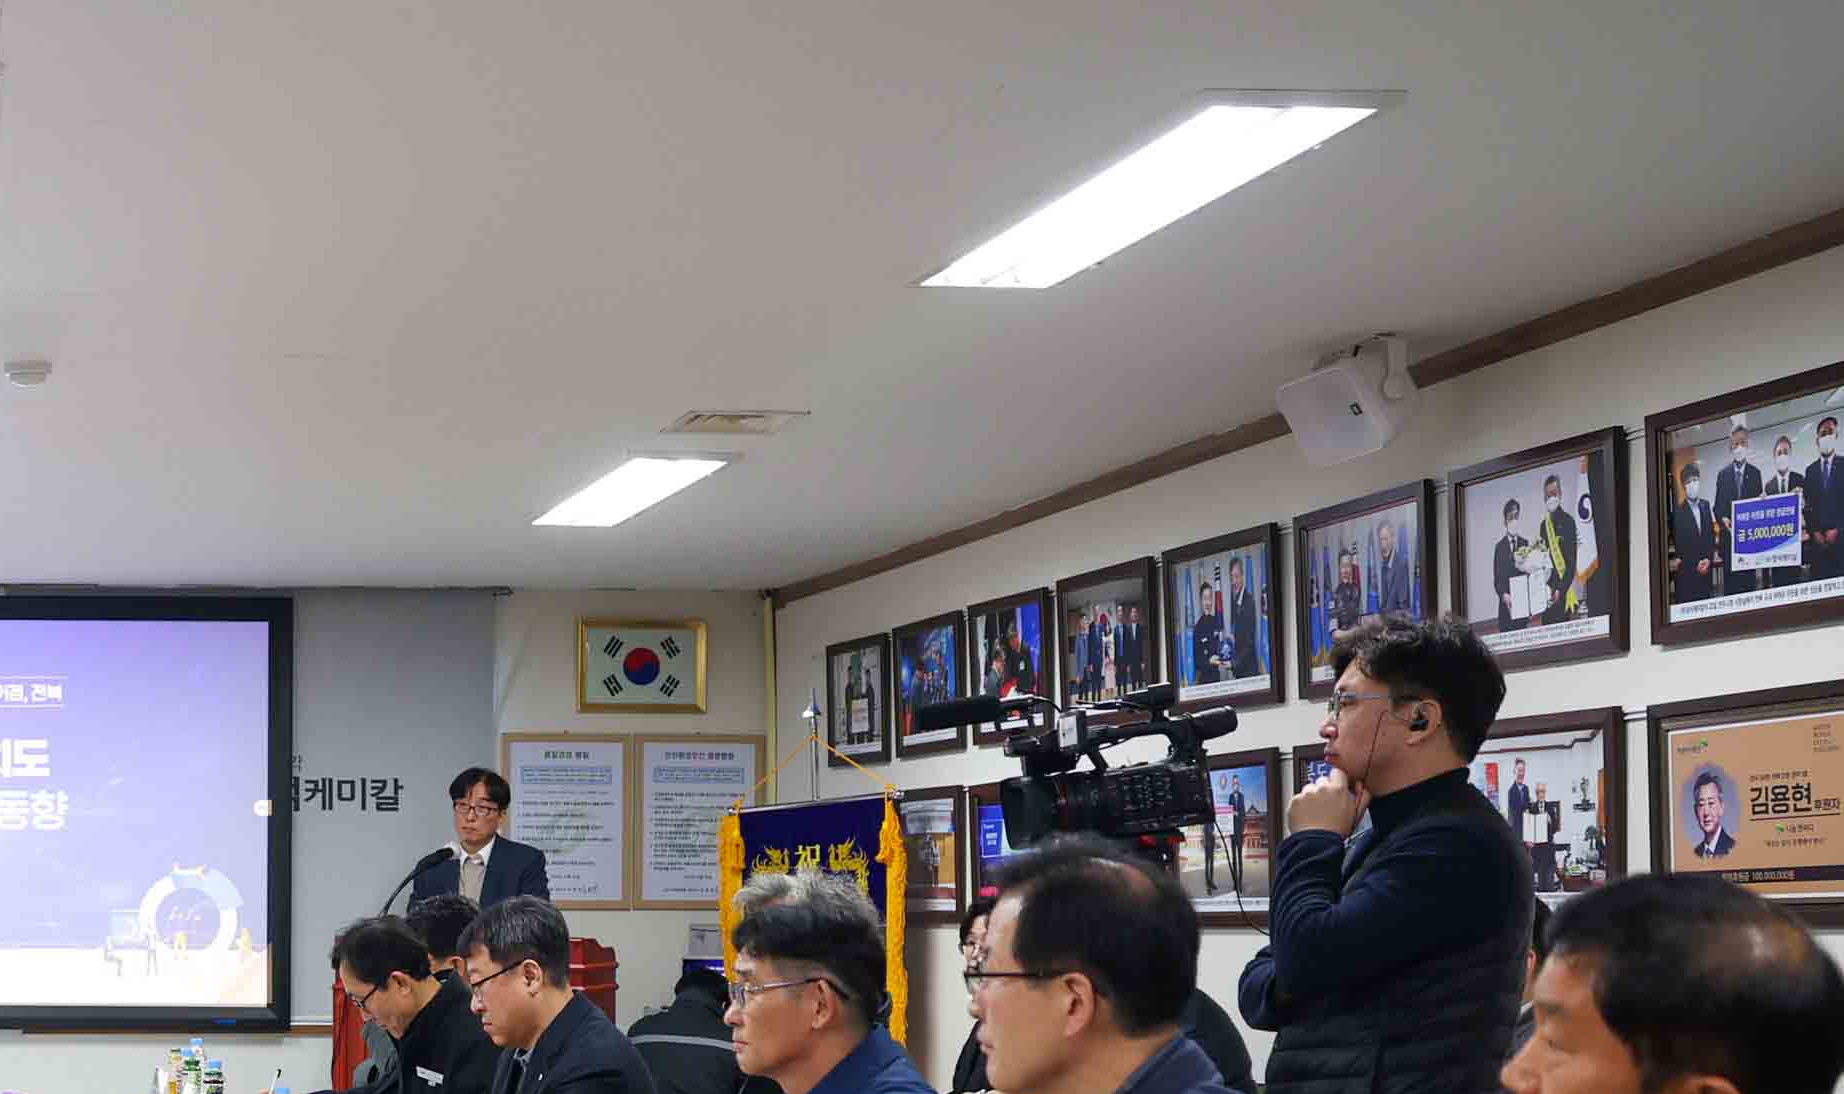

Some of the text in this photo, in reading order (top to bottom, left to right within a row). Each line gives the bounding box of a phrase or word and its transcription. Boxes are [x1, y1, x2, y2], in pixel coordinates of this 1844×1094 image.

[31, 684, 63, 702] 전북
[1750, 782, 1812, 815] 김용현
[794, 844, 820, 872] 祝
